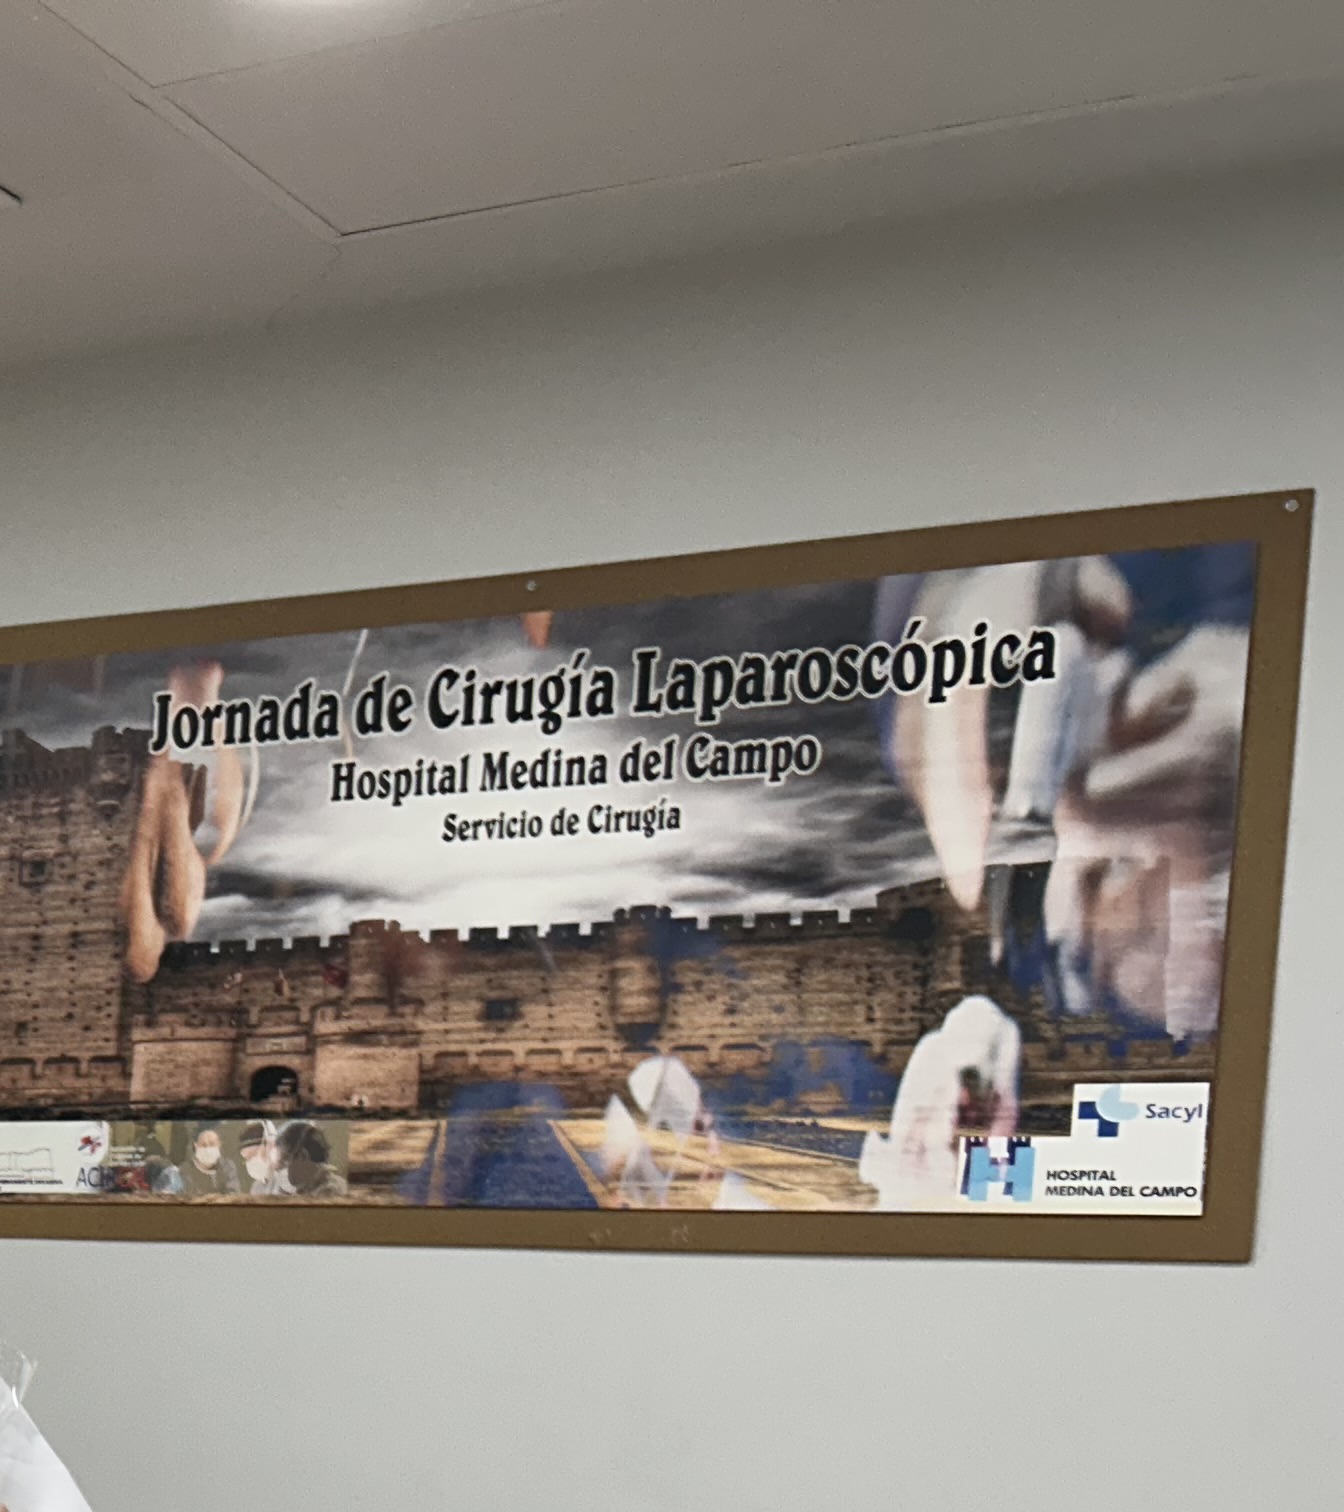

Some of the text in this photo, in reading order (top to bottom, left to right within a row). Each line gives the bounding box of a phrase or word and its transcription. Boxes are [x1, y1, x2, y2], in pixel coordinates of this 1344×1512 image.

[150, 619, 1058, 753] Jornada de Cirugía Laparoscópica
[330, 735, 819, 806] Hospital Medina del Campo
[441, 798, 682, 842] Servicio de Cirugía
[1145, 1103, 1204, 1122] Sacyl
[1046, 1169, 1117, 1182] HOSPITAL
[1045, 1186, 1198, 1198] MEDINA DEL CAMPO
